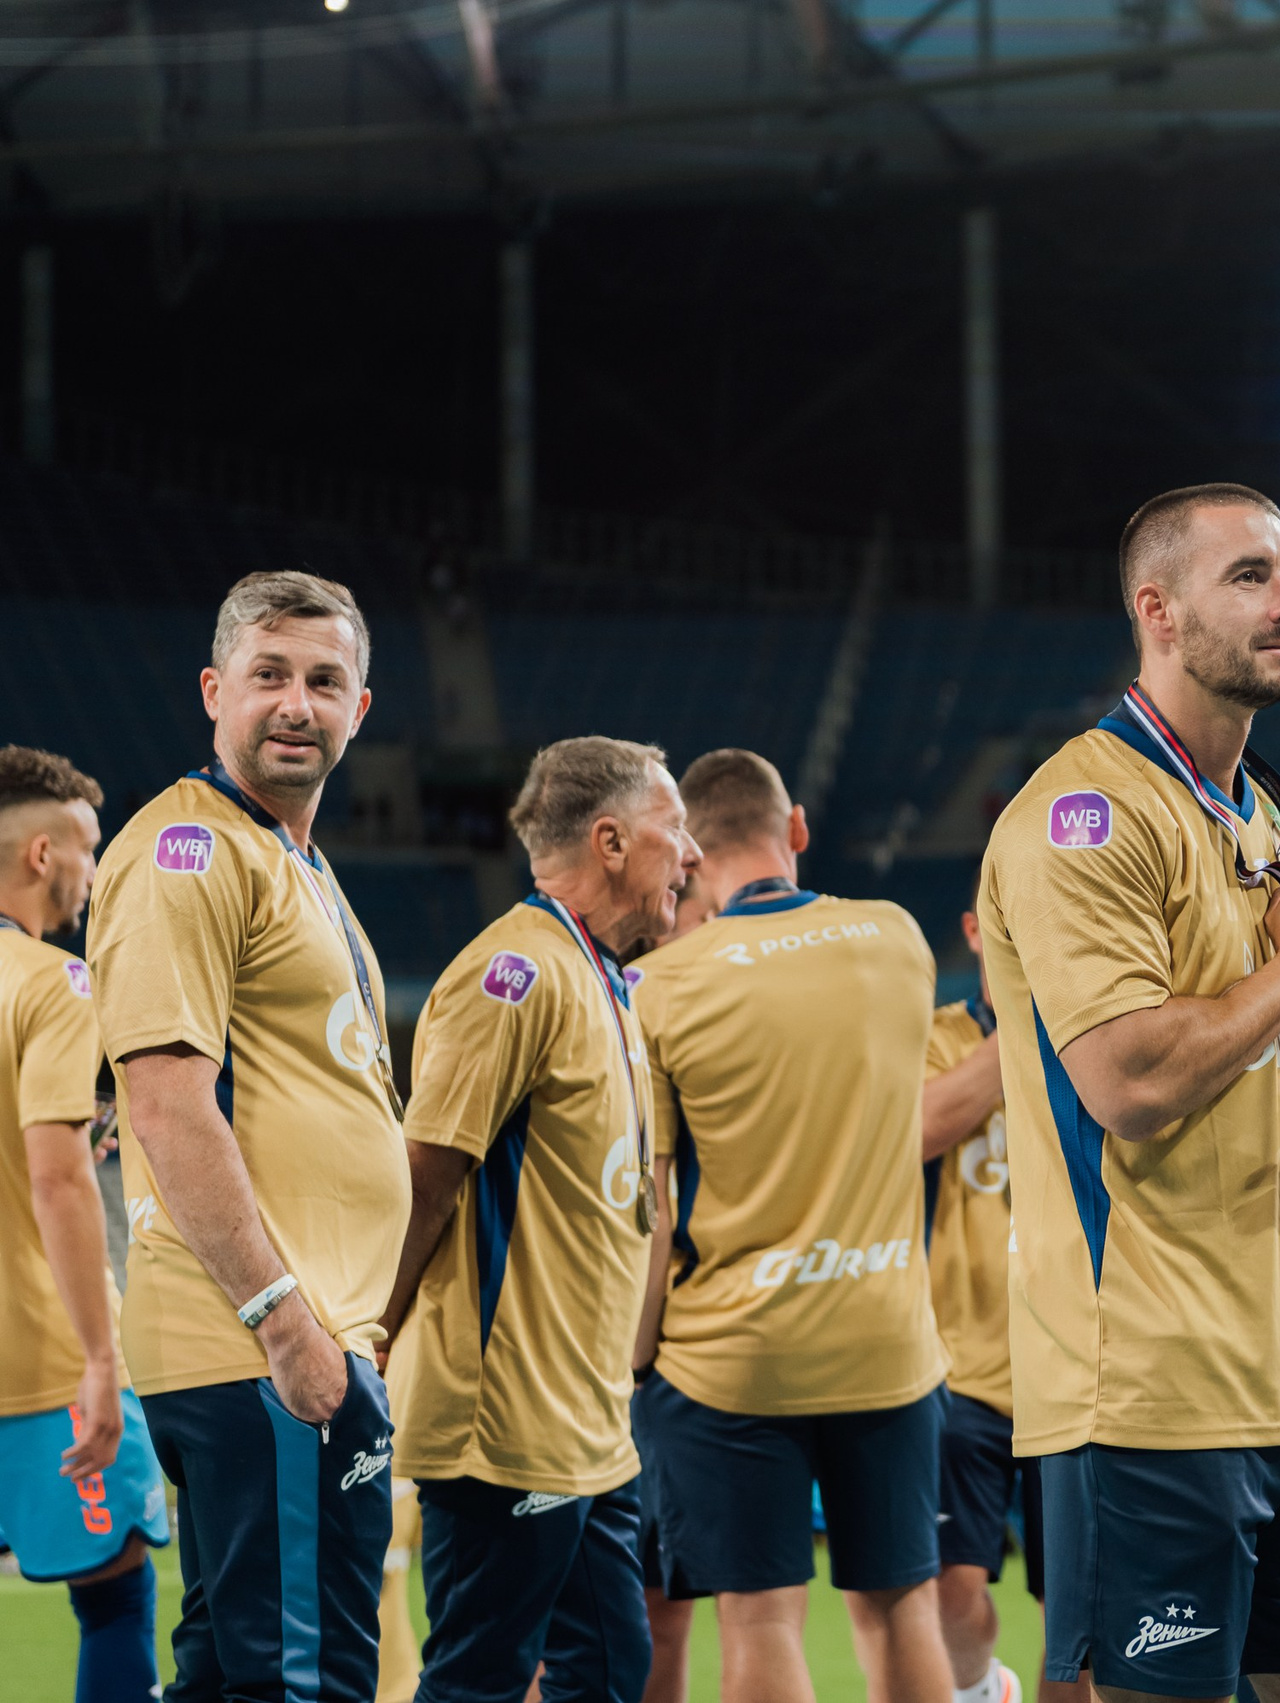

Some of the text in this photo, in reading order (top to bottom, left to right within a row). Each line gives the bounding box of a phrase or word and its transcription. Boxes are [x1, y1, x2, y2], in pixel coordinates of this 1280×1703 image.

[1059, 809, 1102, 829] WB
[166, 837, 204, 856] WB
[759, 921, 881, 956] РОССИЯ
[495, 966, 527, 990] WB
[1125, 1615, 1221, 1658] Зенит
